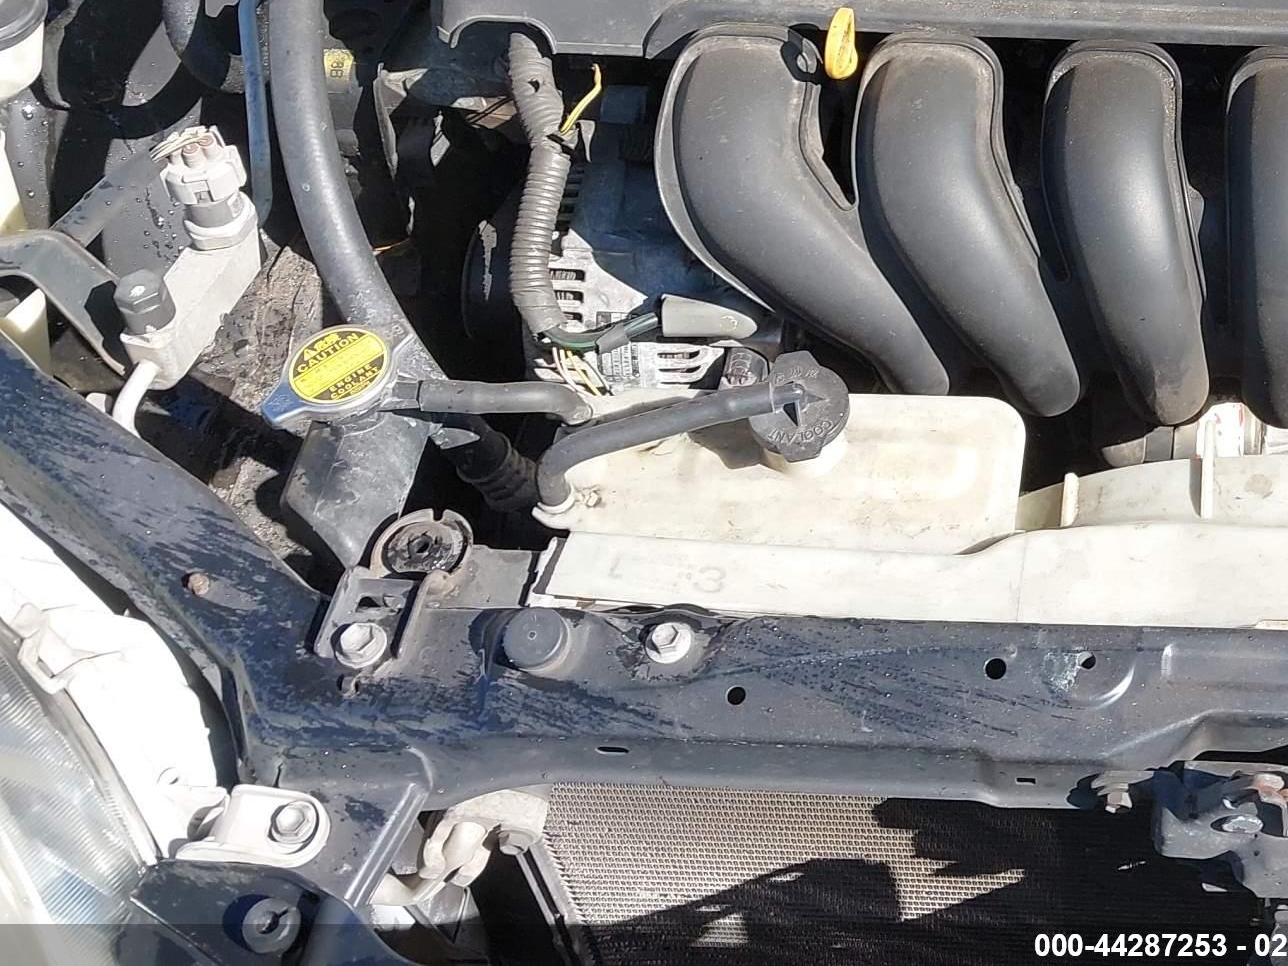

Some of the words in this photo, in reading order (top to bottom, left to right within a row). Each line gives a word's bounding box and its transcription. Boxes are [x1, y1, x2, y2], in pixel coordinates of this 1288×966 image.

[296, 332, 359, 373] CAUTION
[328, 364, 372, 393] ENGINE
[330, 366, 379, 399] COOLANT
[768, 420, 833, 445] COOLANT
